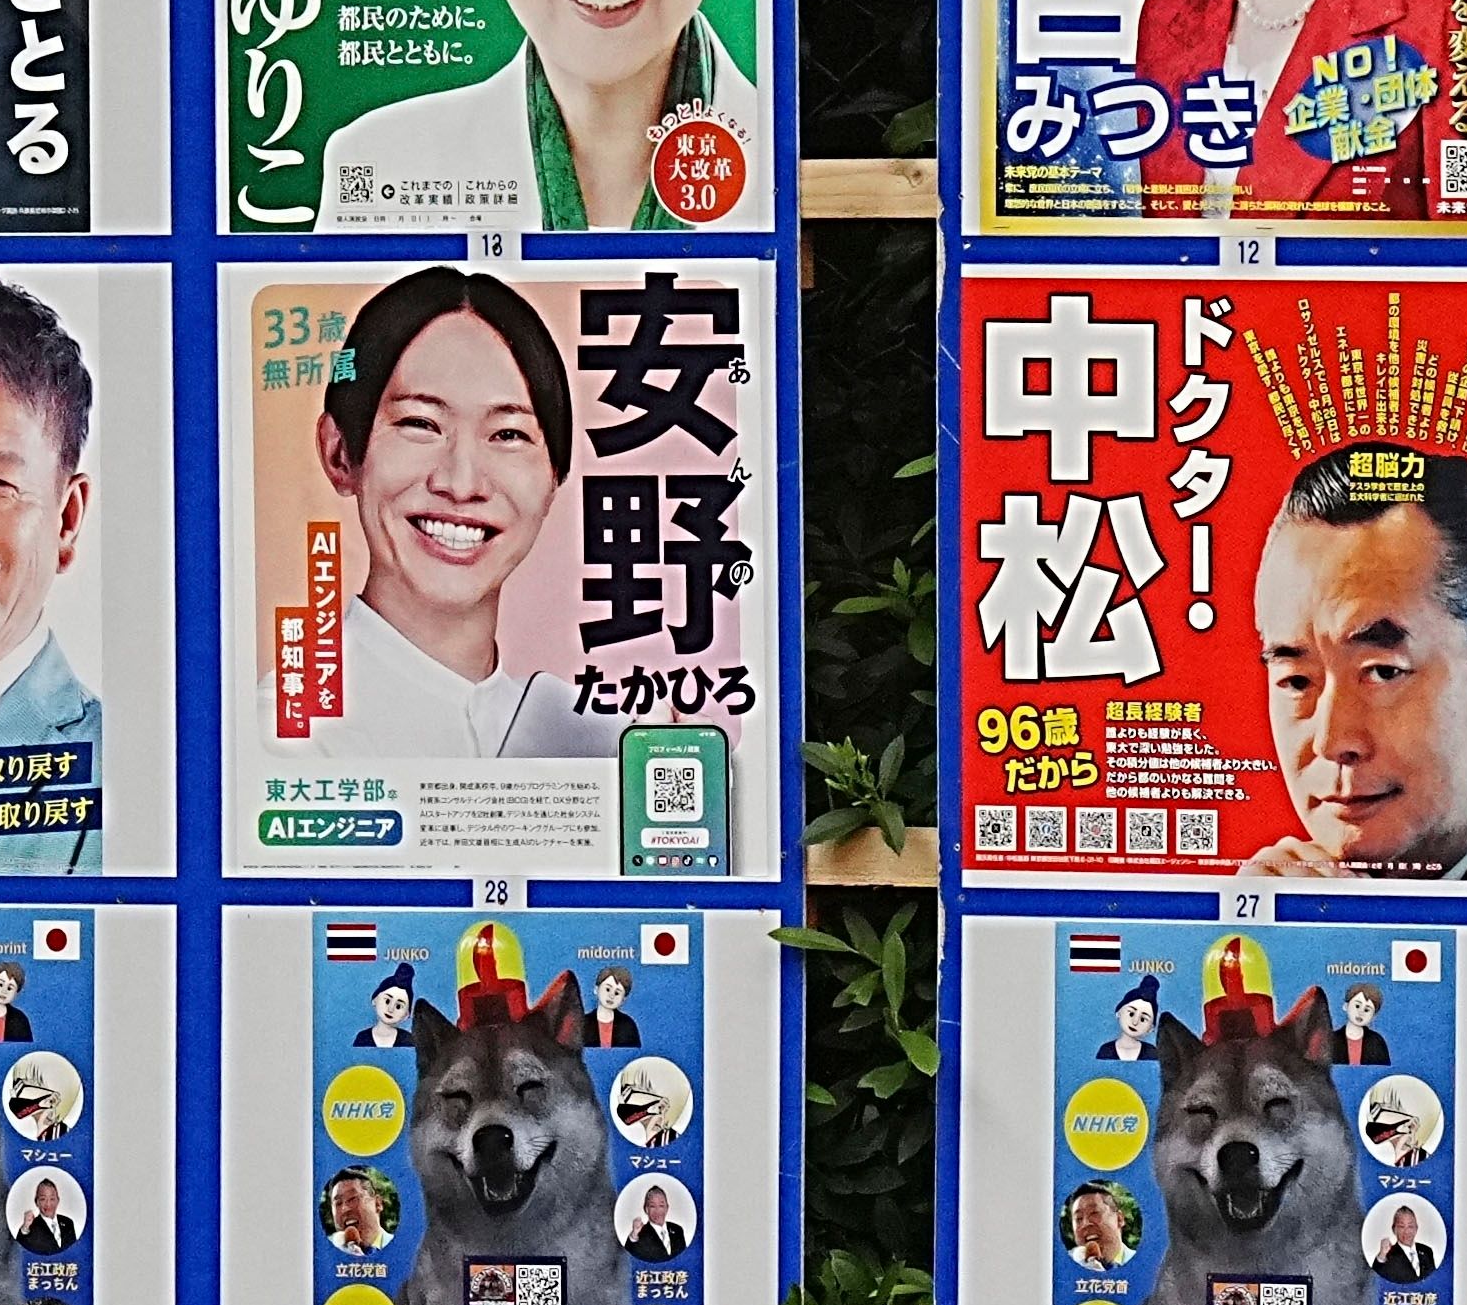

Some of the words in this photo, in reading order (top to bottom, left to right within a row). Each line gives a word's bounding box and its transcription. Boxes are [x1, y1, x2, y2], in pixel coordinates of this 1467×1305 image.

[338, 6, 486, 32] 都民のために。
[338, 41, 474, 67] 都民とともに。
[1006, 74, 1256, 169] みつき
[676, 135, 717, 155] 東京
[1330, 116, 1397, 163] 献金
[668, 159, 732, 181] 大改革
[400, 181, 452, 191] これまでの
[465, 181, 517, 191] これからの
[680, 185, 716, 210] 3.0
[400, 194, 453, 205] 改革実績
[465, 194, 518, 205] 政策詳細
[1238, 241, 1259, 264] 12
[263, 305, 347, 349] 33歳
[262, 348, 357, 391] 無所属
[577, 272, 754, 655] 安野
[1349, 452, 1425, 478] 超脳力
[978, 294, 1165, 684] 中松
[311, 532, 339, 711] AIエンジニアを
[281, 618, 306, 732] 都知事に。
[573, 665, 756, 717] たかひろ
[1106, 701, 1202, 722] 超長経験者
[977, 706, 1078, 754] 96歳
[1005, 752, 1099, 792] だから
[267, 817, 395, 841] AIエンジニア
[485, 880, 507, 904] 28
